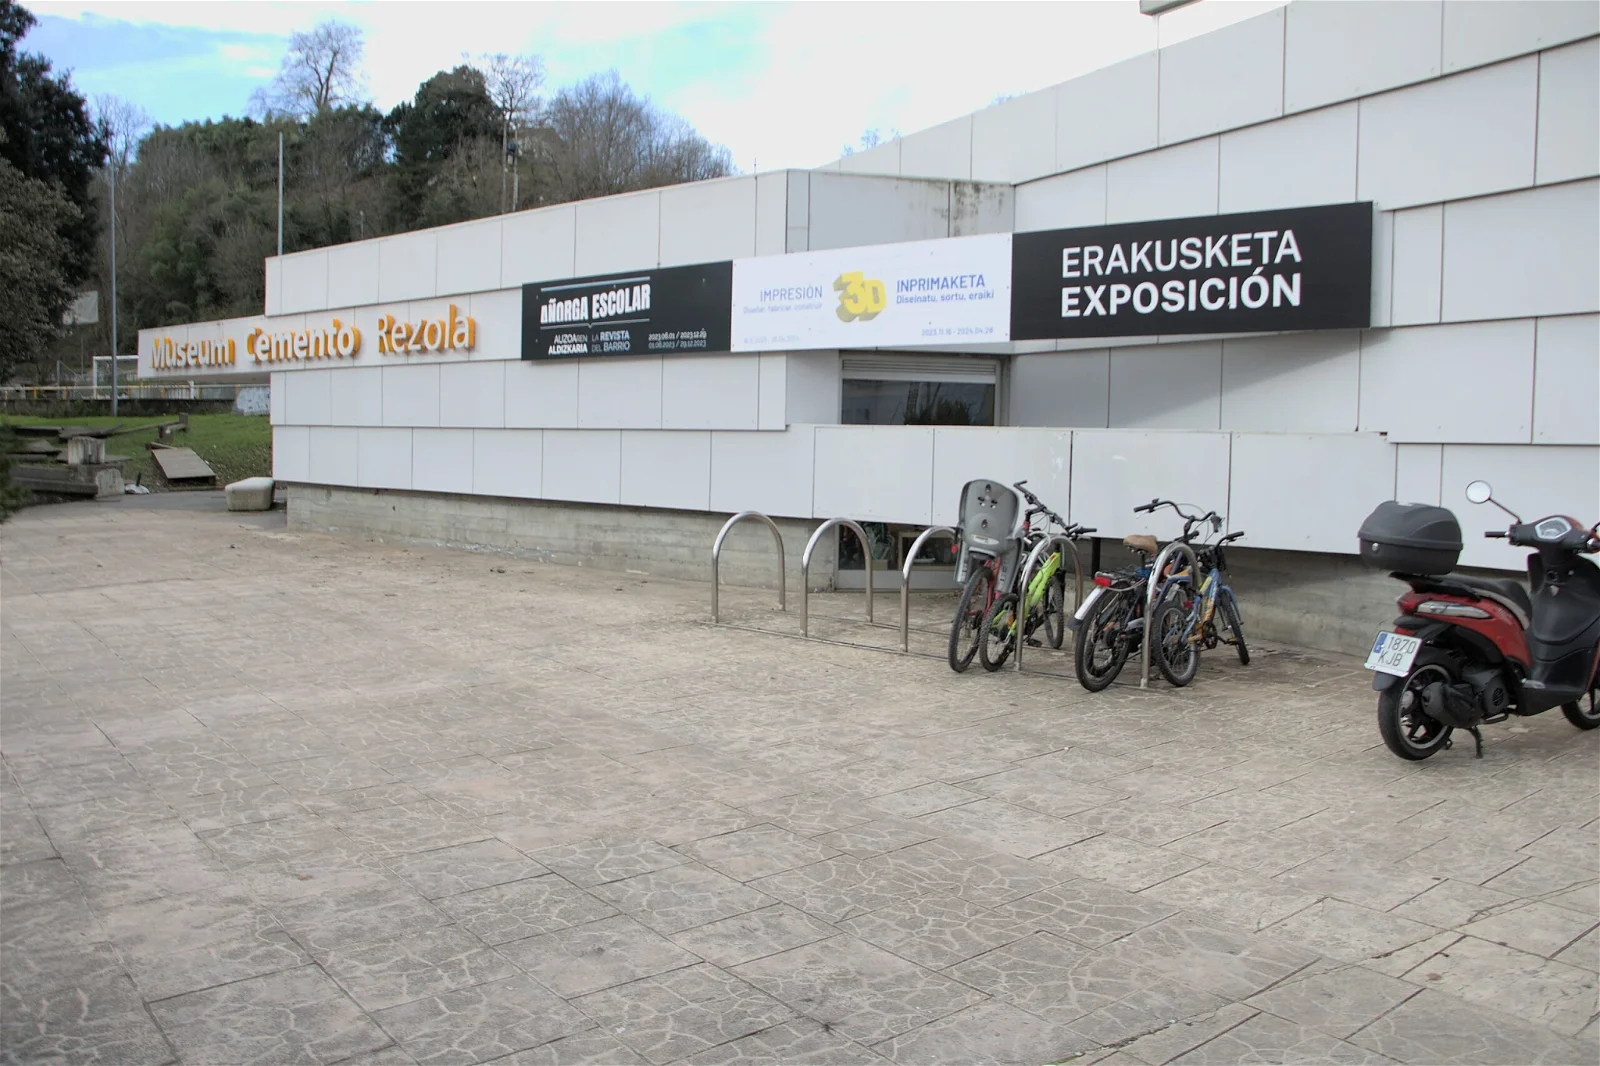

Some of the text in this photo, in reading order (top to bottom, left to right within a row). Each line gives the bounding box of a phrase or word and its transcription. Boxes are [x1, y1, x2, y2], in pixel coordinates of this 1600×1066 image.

[1062, 229, 1302, 278] ERAKUSKETA
[896, 274, 985, 293] INPRIMAKETA
[1062, 267, 1302, 317] EXPOSICIÓN
[760, 283, 823, 303] IMPRESIÓN
[833, 271, 886, 323] 3D
[896, 289, 995, 304] Diseinatu, sortu, eraiki
[540, 283, 651, 325] AÑORGA ESCOLAR
[151, 304, 476, 371] Museum Cemento Rezola
[554, 333, 588, 344] AUZOAREN
[591, 330, 631, 342] LA REVISTA
[548, 343, 588, 355] ALDIZKARIA
[591, 341, 631, 353] DEL BARRIO
[1387, 636, 1417, 654] 1870
[1378, 650, 1403, 666] KJB
